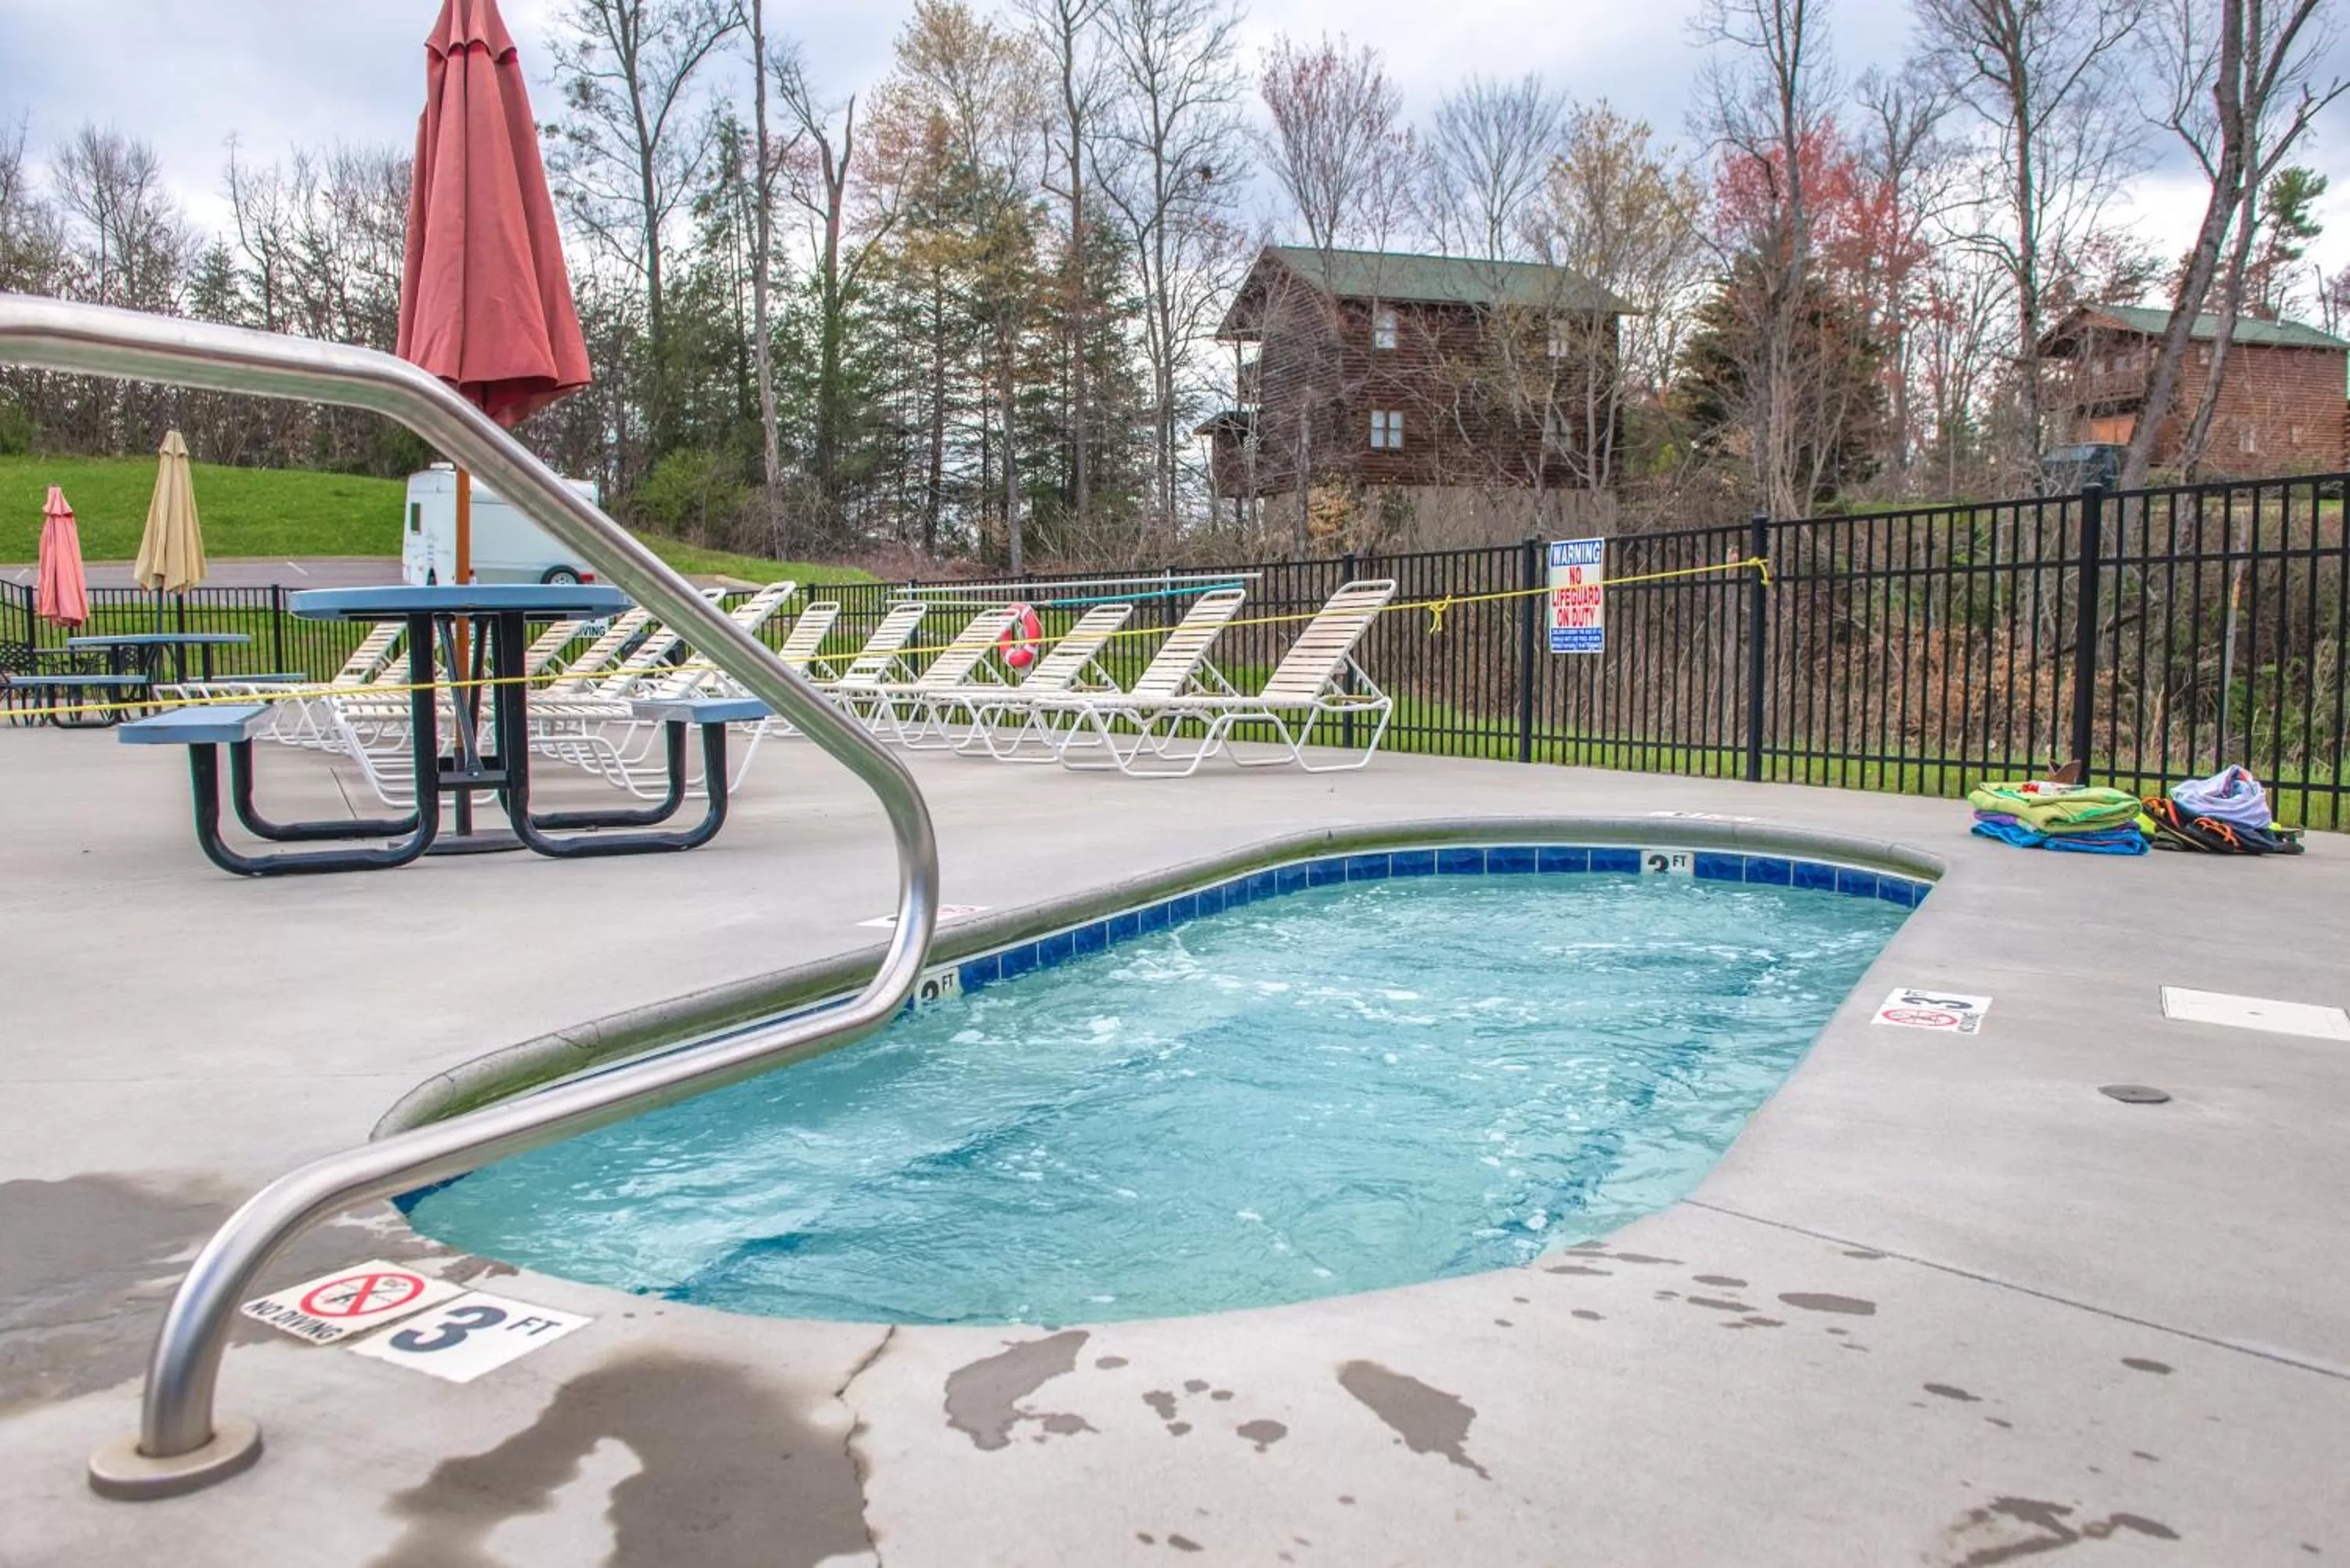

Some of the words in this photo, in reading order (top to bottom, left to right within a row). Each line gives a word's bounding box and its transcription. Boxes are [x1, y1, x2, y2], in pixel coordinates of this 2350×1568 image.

[1553, 542, 1600, 565] WARNING
[1569, 566, 1582, 586] NO
[1553, 586, 1601, 607] LIFEGUARD
[1557, 608, 1569, 627] ON
[1572, 607, 1595, 627] DUTY
[576, 626, 606, 637] IVING
[1672, 854, 1687, 867] FT
[942, 974, 954, 991] FT
[245, 1300, 284, 1316] NO
[270, 1310, 343, 1339] DIVING
[389, 1306, 507, 1353] 3
[505, 1316, 562, 1337] FT
